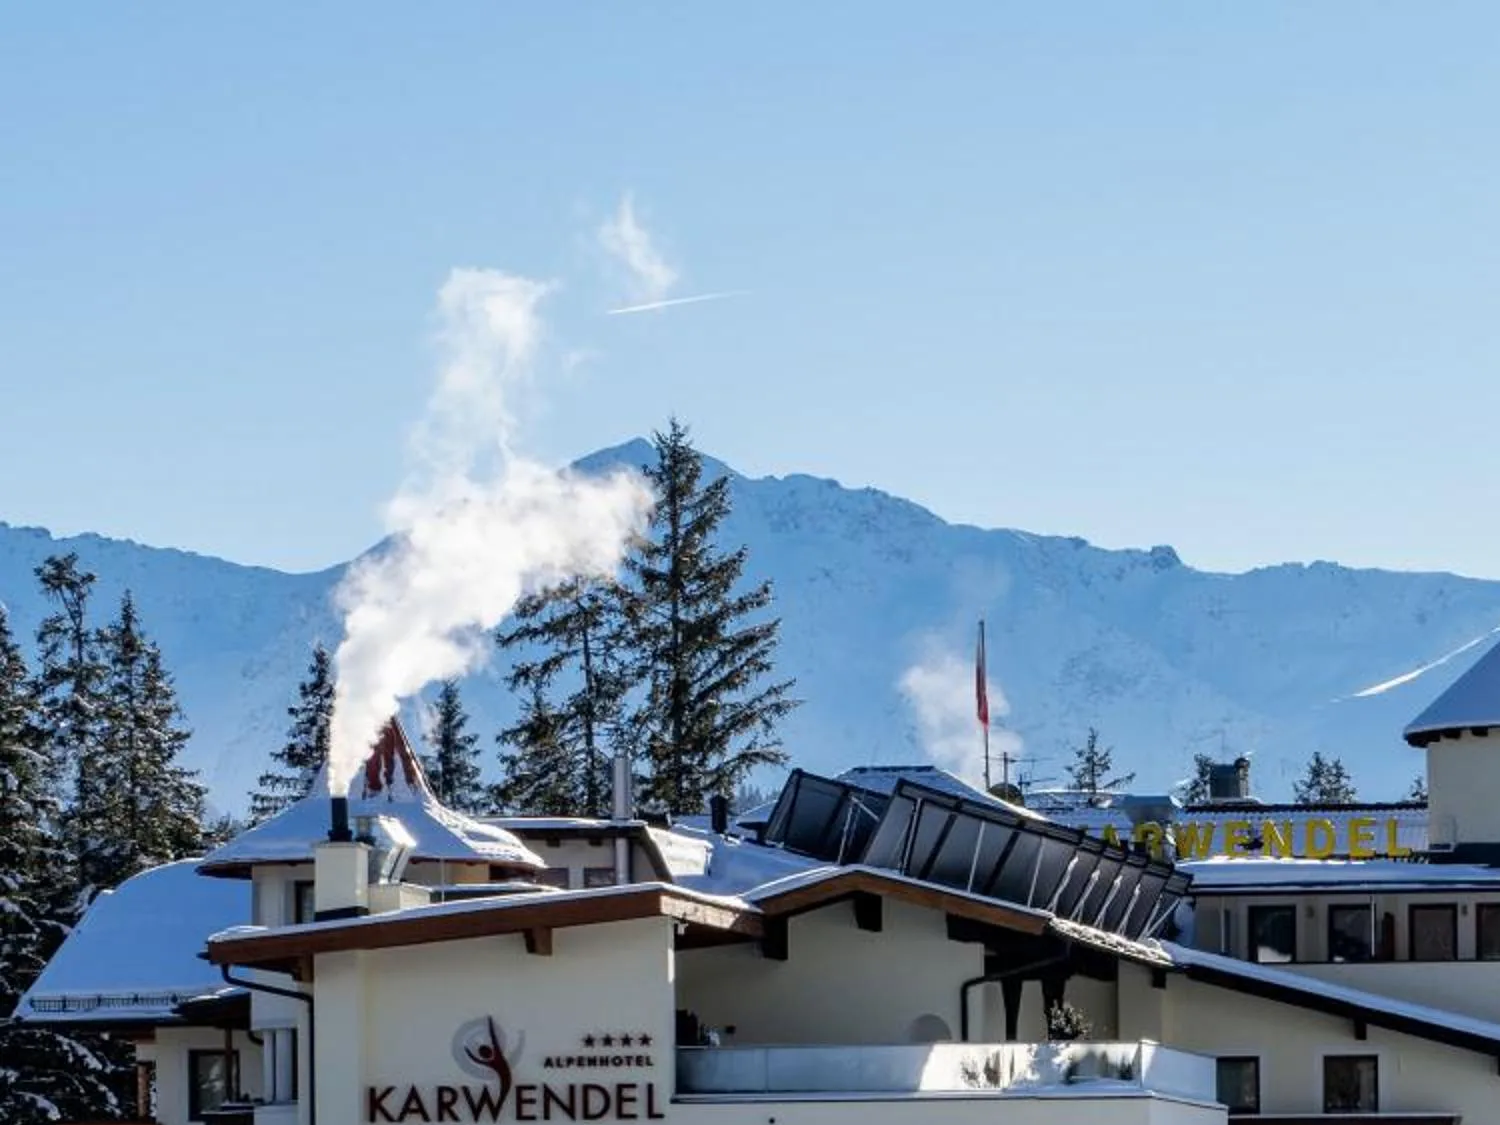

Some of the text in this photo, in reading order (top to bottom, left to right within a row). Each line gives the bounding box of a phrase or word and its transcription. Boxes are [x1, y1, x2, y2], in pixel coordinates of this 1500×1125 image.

[1078, 818, 1413, 860] ARWENDEL
[543, 1055, 654, 1069] ALPENHOTEL
[367, 1083, 665, 1123] KARWENDEL
